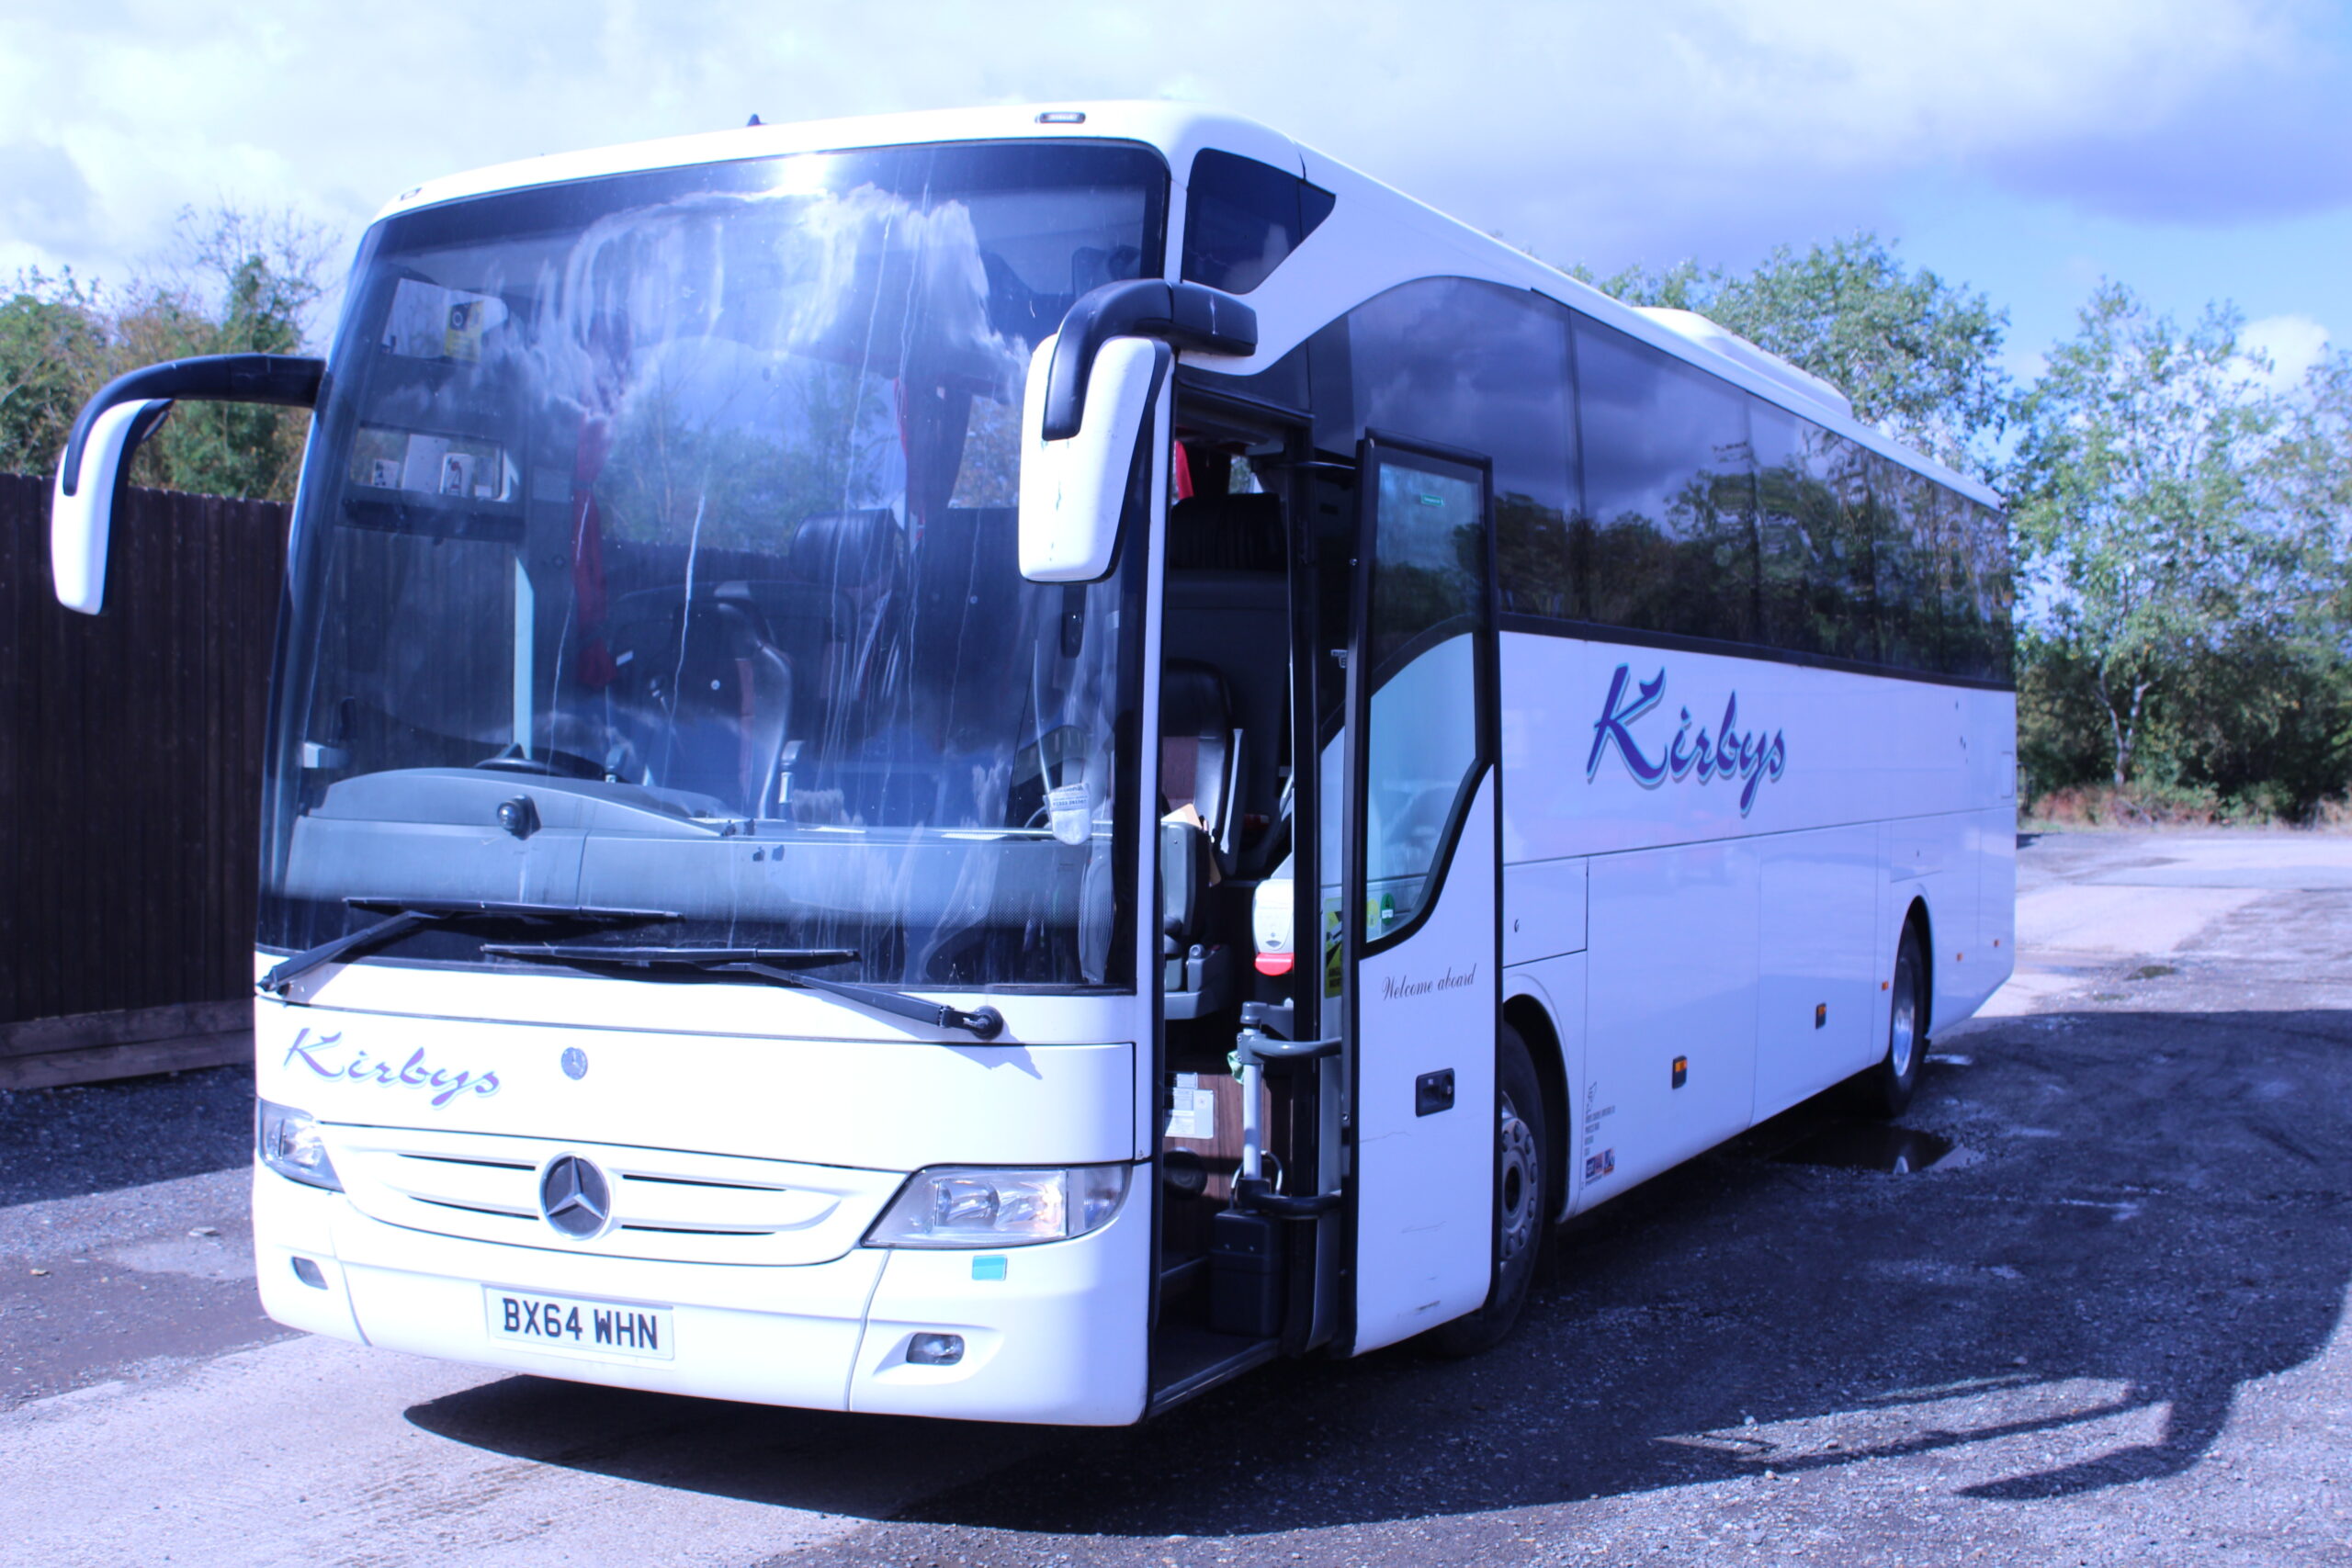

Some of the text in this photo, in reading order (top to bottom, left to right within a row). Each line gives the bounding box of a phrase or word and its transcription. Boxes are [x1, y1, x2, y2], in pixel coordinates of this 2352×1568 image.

[1587, 663, 1785, 818] Kirbys
[1382, 963, 1477, 1001] Welcome aboard
[283, 1027, 501, 1108] Kirbys
[503, 1297, 658, 1350] BX64 WHN
